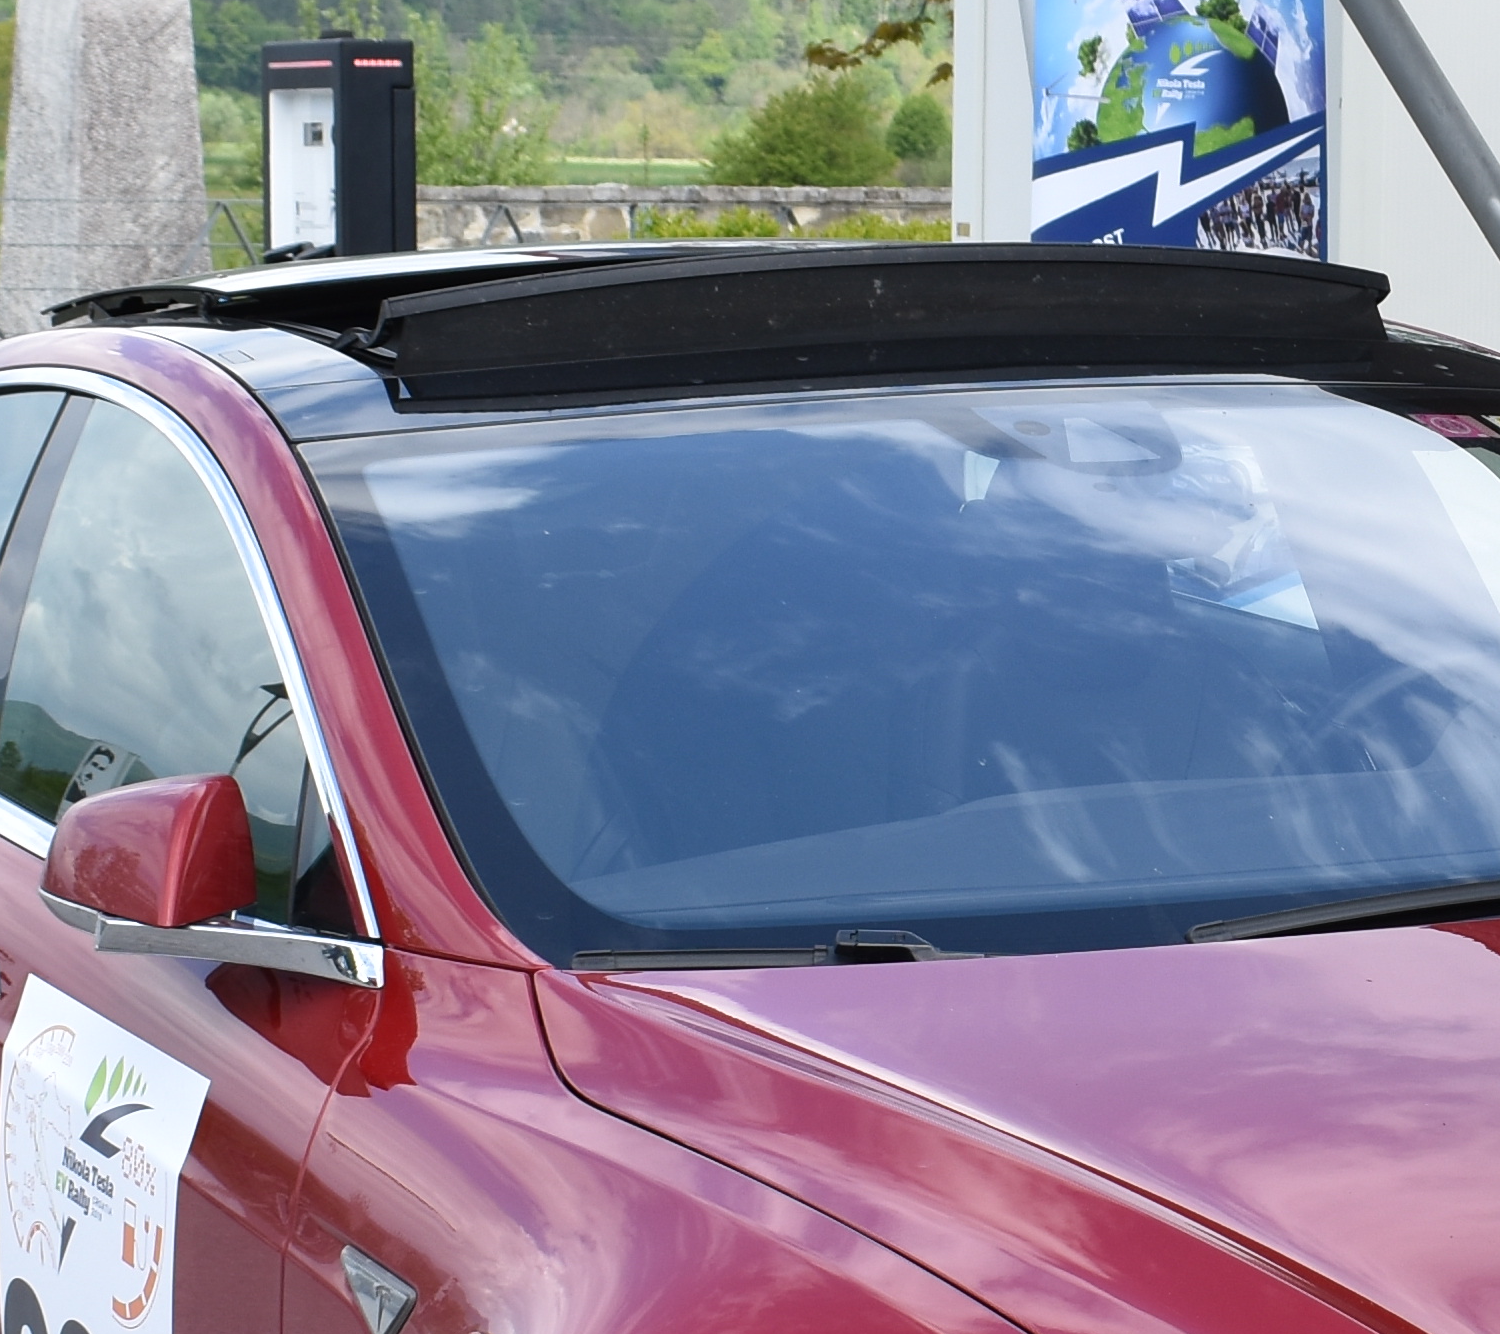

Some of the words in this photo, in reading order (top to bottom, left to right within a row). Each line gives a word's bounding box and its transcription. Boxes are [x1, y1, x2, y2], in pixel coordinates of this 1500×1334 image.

[56, 1170, 68, 1194] EV
[67, 1178, 91, 1216] Rally
[62, 1146, 91, 1183] Nikola
[92, 1165, 114, 1199] Tesla
